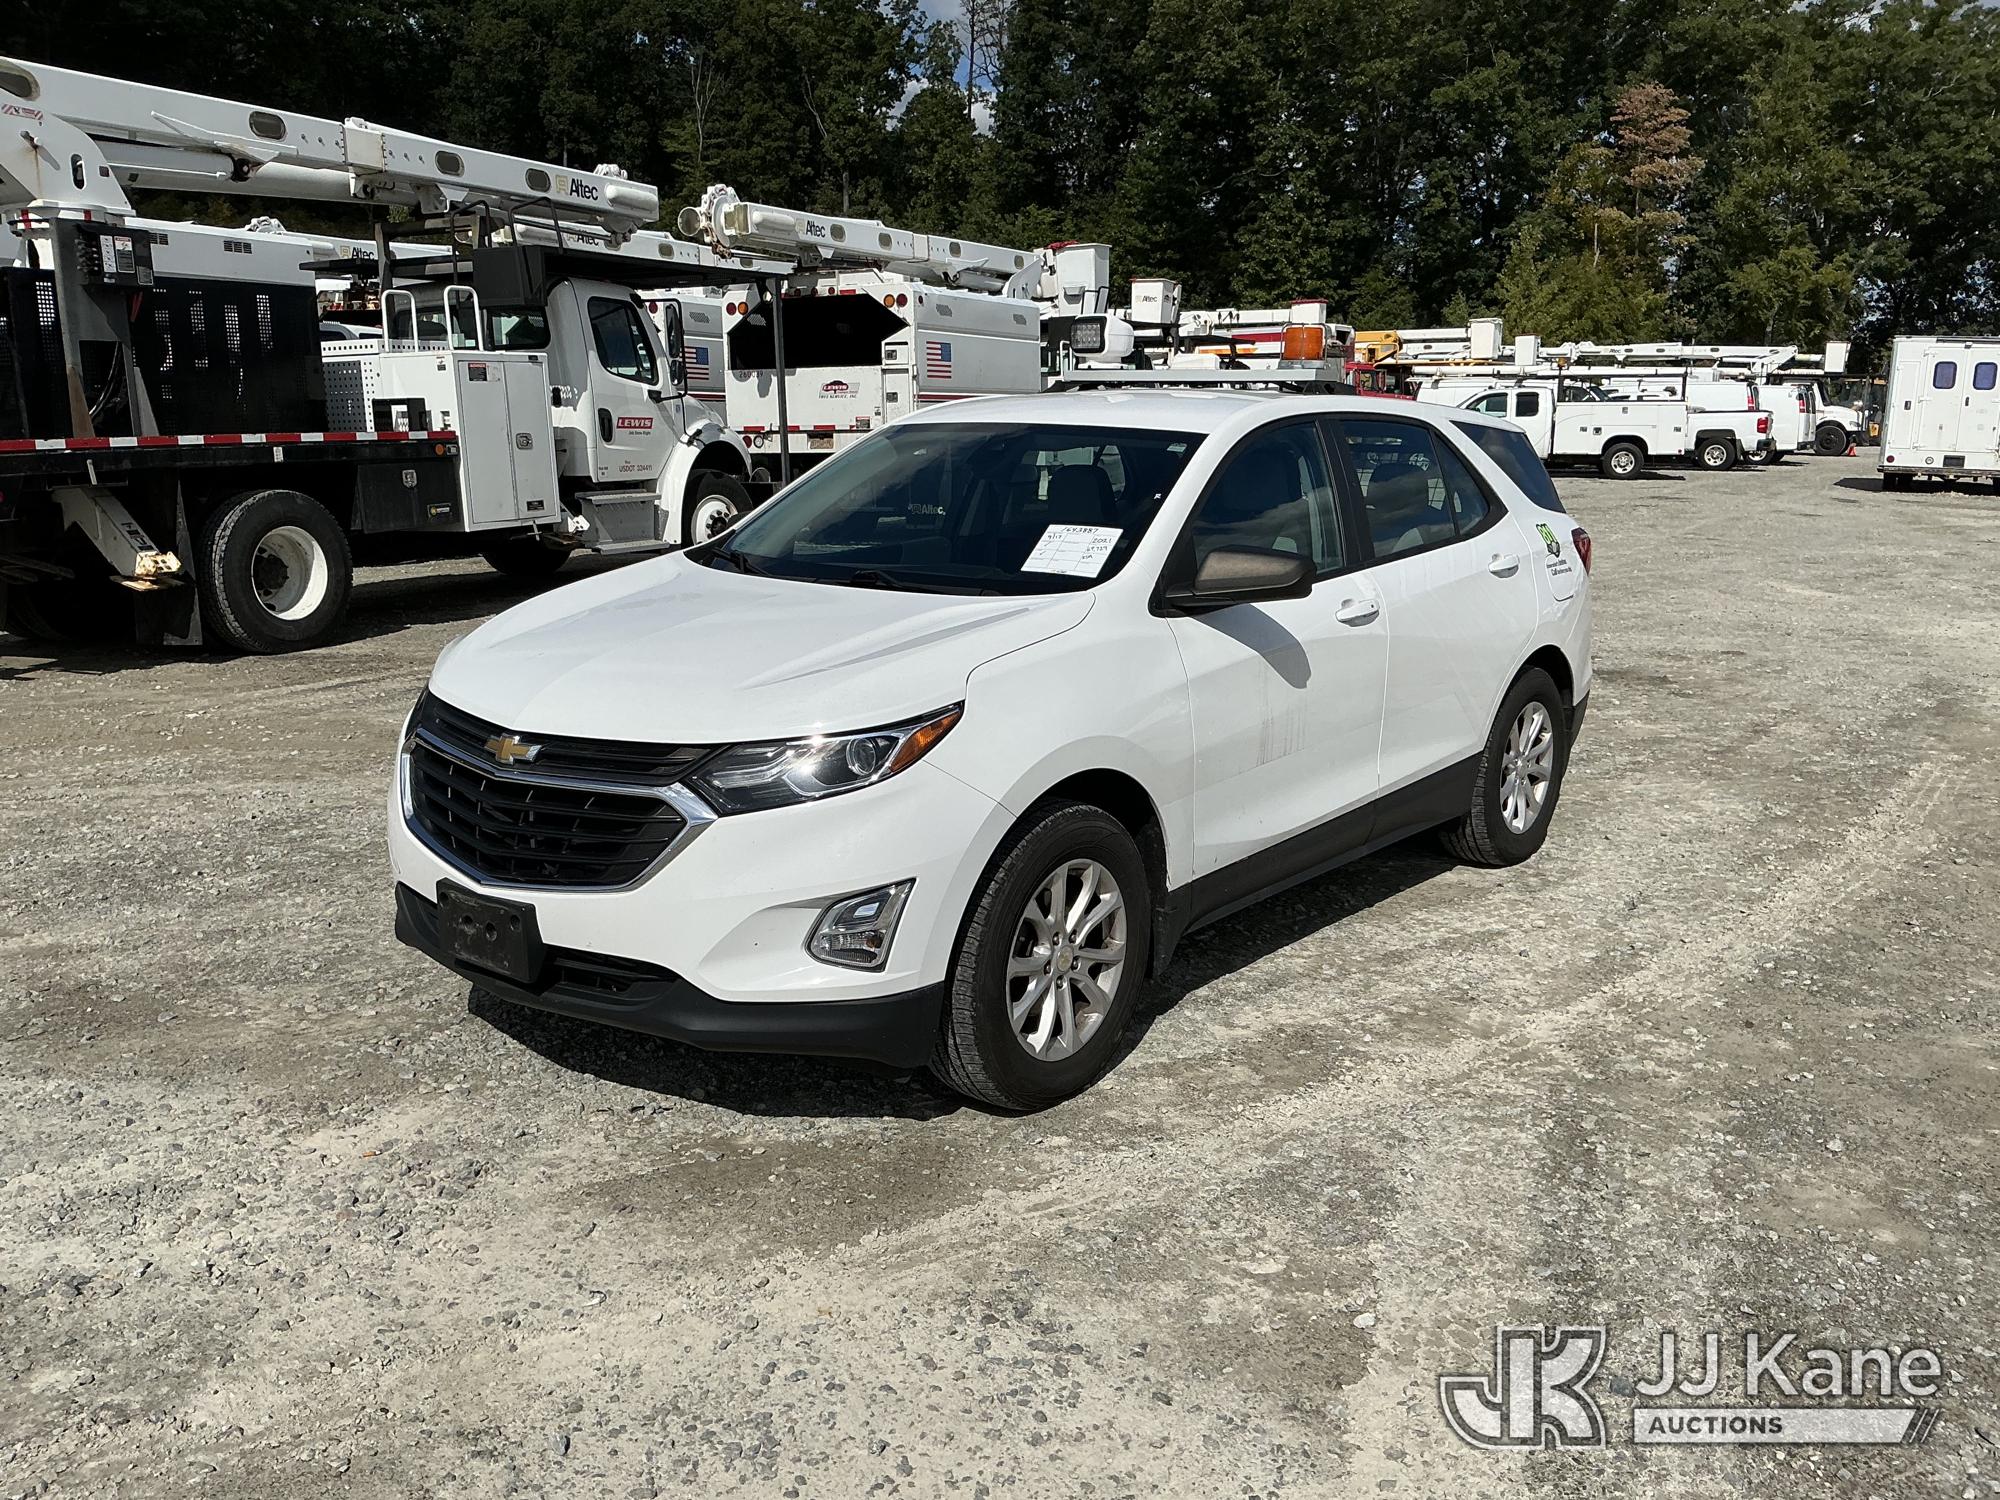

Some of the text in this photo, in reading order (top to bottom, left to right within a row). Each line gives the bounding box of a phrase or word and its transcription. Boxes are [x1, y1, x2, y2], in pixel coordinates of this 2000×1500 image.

[569, 177, 599, 201] Altec
[806, 220, 826, 238] Altec
[351, 246, 375, 260] Altec
[617, 418, 652, 428] LEWIS
